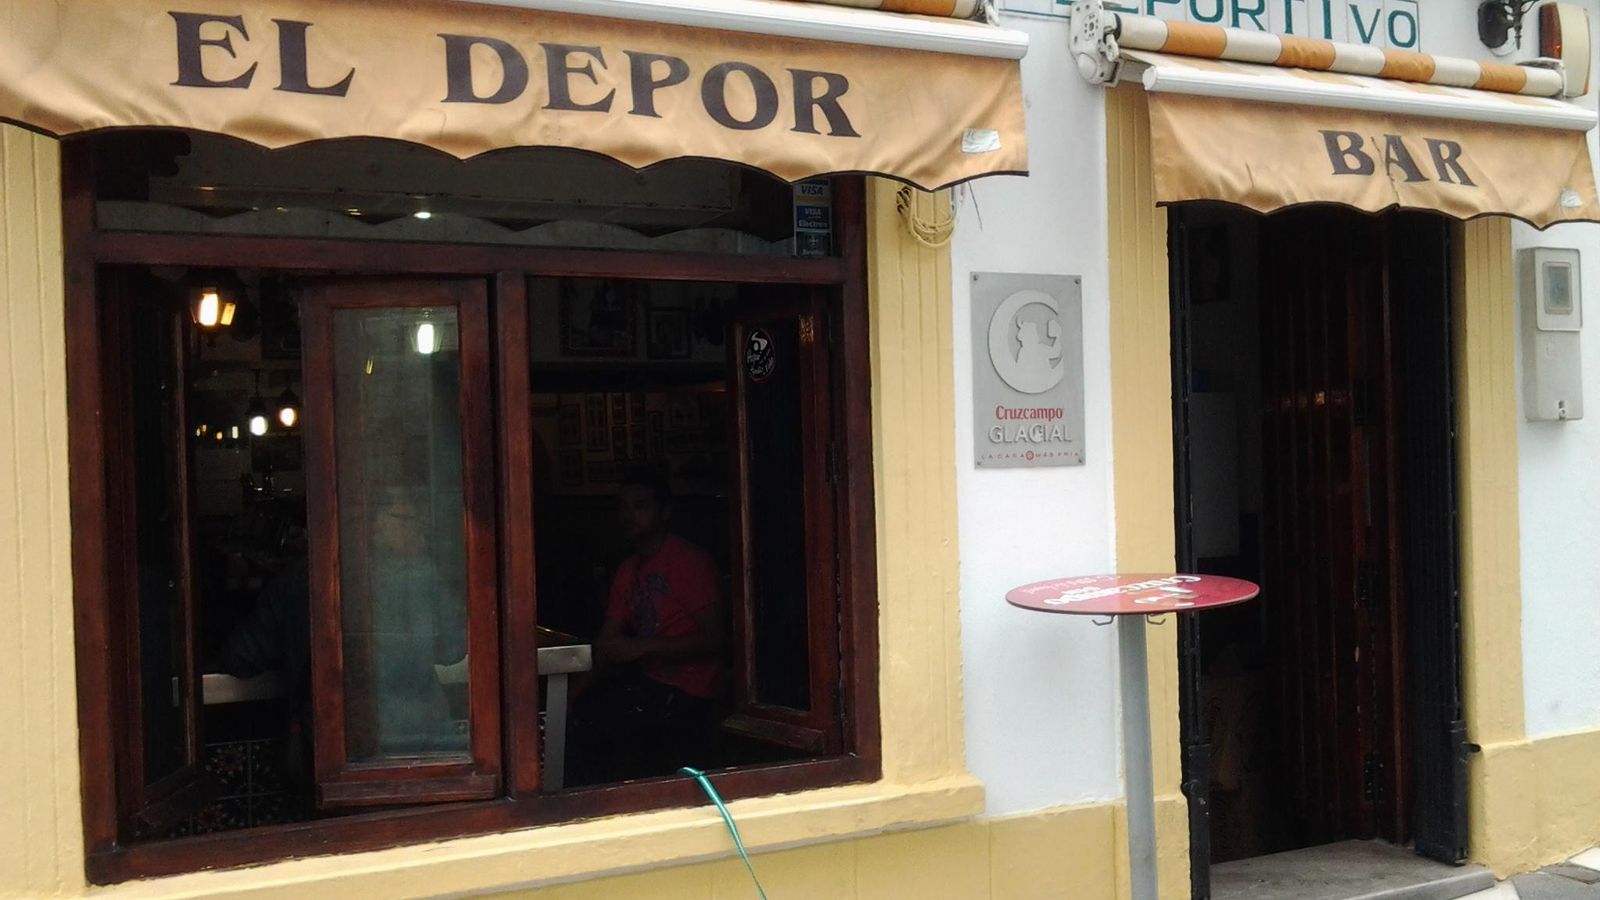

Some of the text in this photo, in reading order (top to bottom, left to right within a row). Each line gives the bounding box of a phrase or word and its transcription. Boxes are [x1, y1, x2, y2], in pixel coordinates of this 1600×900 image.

[168, 11, 861, 138] EL DEPOR
[1318, 130, 1478, 187] BAR
[801, 184, 824, 195] VISA
[995, 405, 1063, 421] Cruzcampo
[988, 424, 1073, 444] GLACIAL
